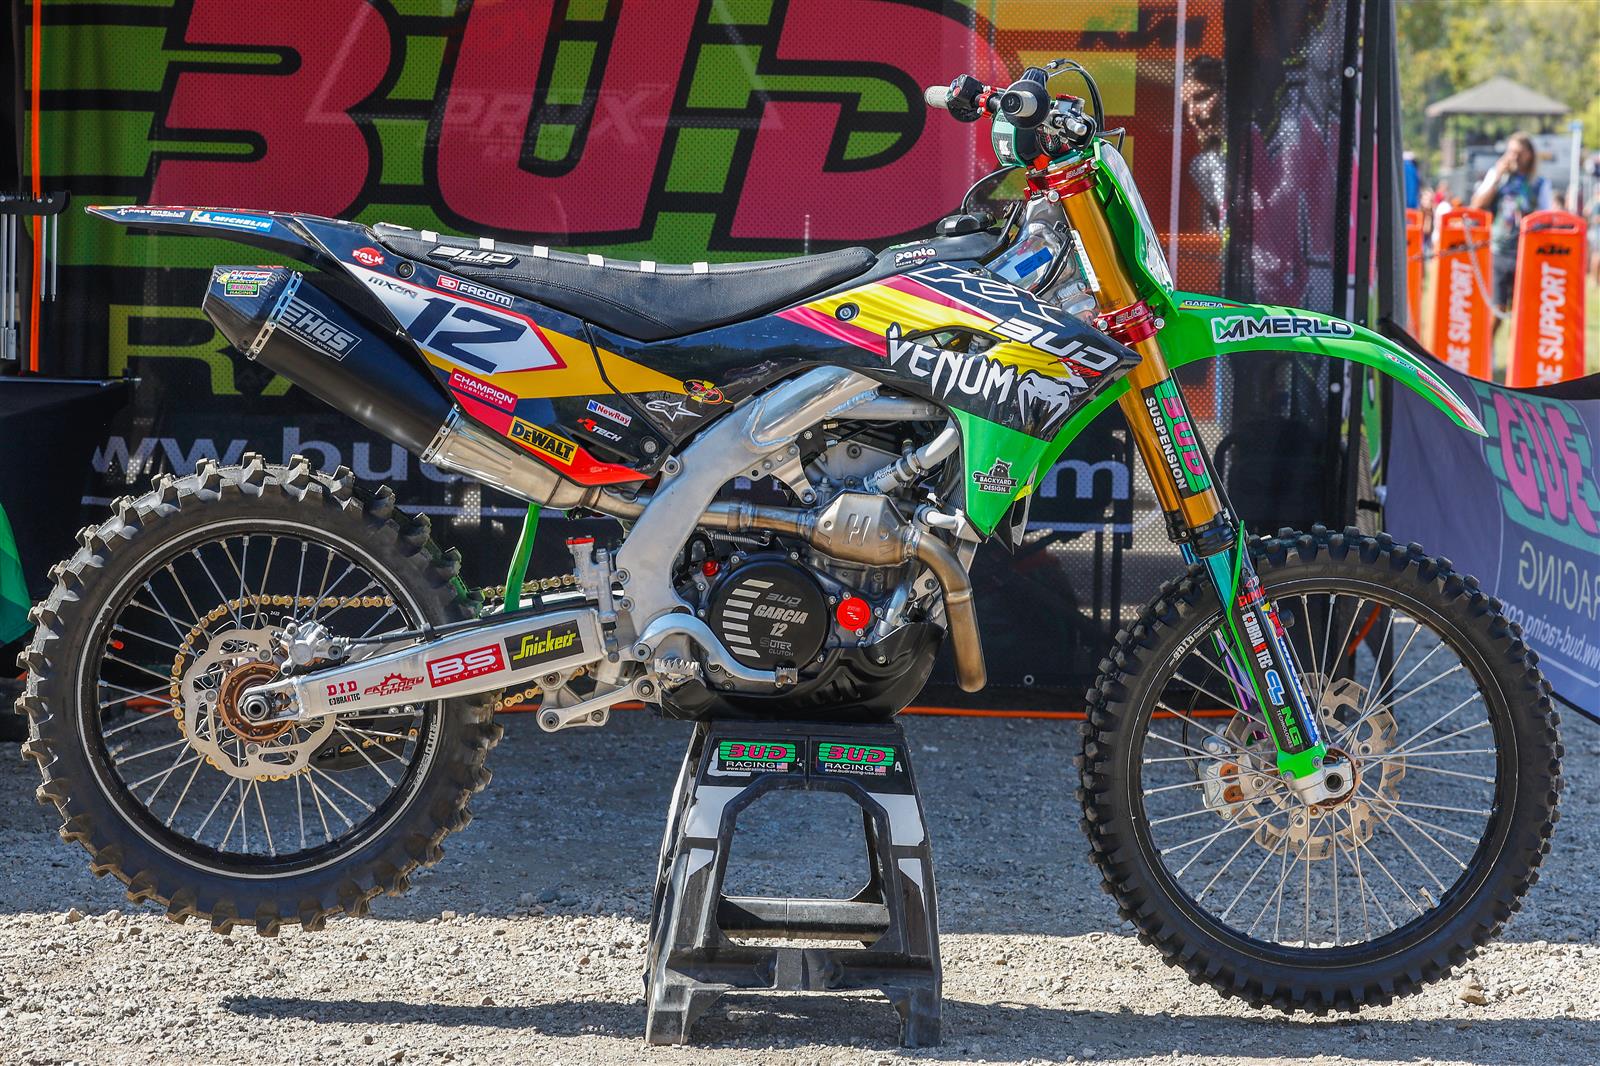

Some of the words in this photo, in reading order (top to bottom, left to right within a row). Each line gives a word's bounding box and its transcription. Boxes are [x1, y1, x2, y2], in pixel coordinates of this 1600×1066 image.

[212, 215, 271, 228] MICHELIN
[352, 249, 385, 265] FALK
[895, 247, 936, 263] panta
[459, 285, 513, 306] FACOM
[1185, 300, 1225, 309] GARCIA
[1448, 258, 1473, 344] SUPPORT
[1537, 260, 1568, 361] SUPPORT
[296, 312, 355, 352] HGS
[405, 296, 528, 374] 12
[1247, 318, 1352, 335] MERLO
[991, 317, 1119, 371] BUD
[886, 325, 1015, 405] VENOM
[453, 373, 514, 404] CHAMPION
[459, 383, 503, 405] LUBRICANTS
[597, 404, 630, 425] NewRay
[1145, 397, 1188, 490] SUSPENSION
[1162, 397, 1205, 476] BUD
[979, 476, 1012, 485] BACKYARD
[983, 484, 1006, 492] DESIGN
[753, 604, 809, 625] GARCIA
[769, 622, 789, 637] 12
[512, 630, 577, 661] Snickers
[768, 648, 794, 657] CLUTCH
[430, 649, 496, 680] BS
[433, 664, 499, 685] BATTERY
[363, 676, 425, 695] FACTORY
[1280, 706, 1303, 747] NG
[728, 744, 787, 760] BUD
[828, 746, 886, 763] BUD
[726, 761, 776, 769] RACING
[824, 762, 874, 772] RACING
